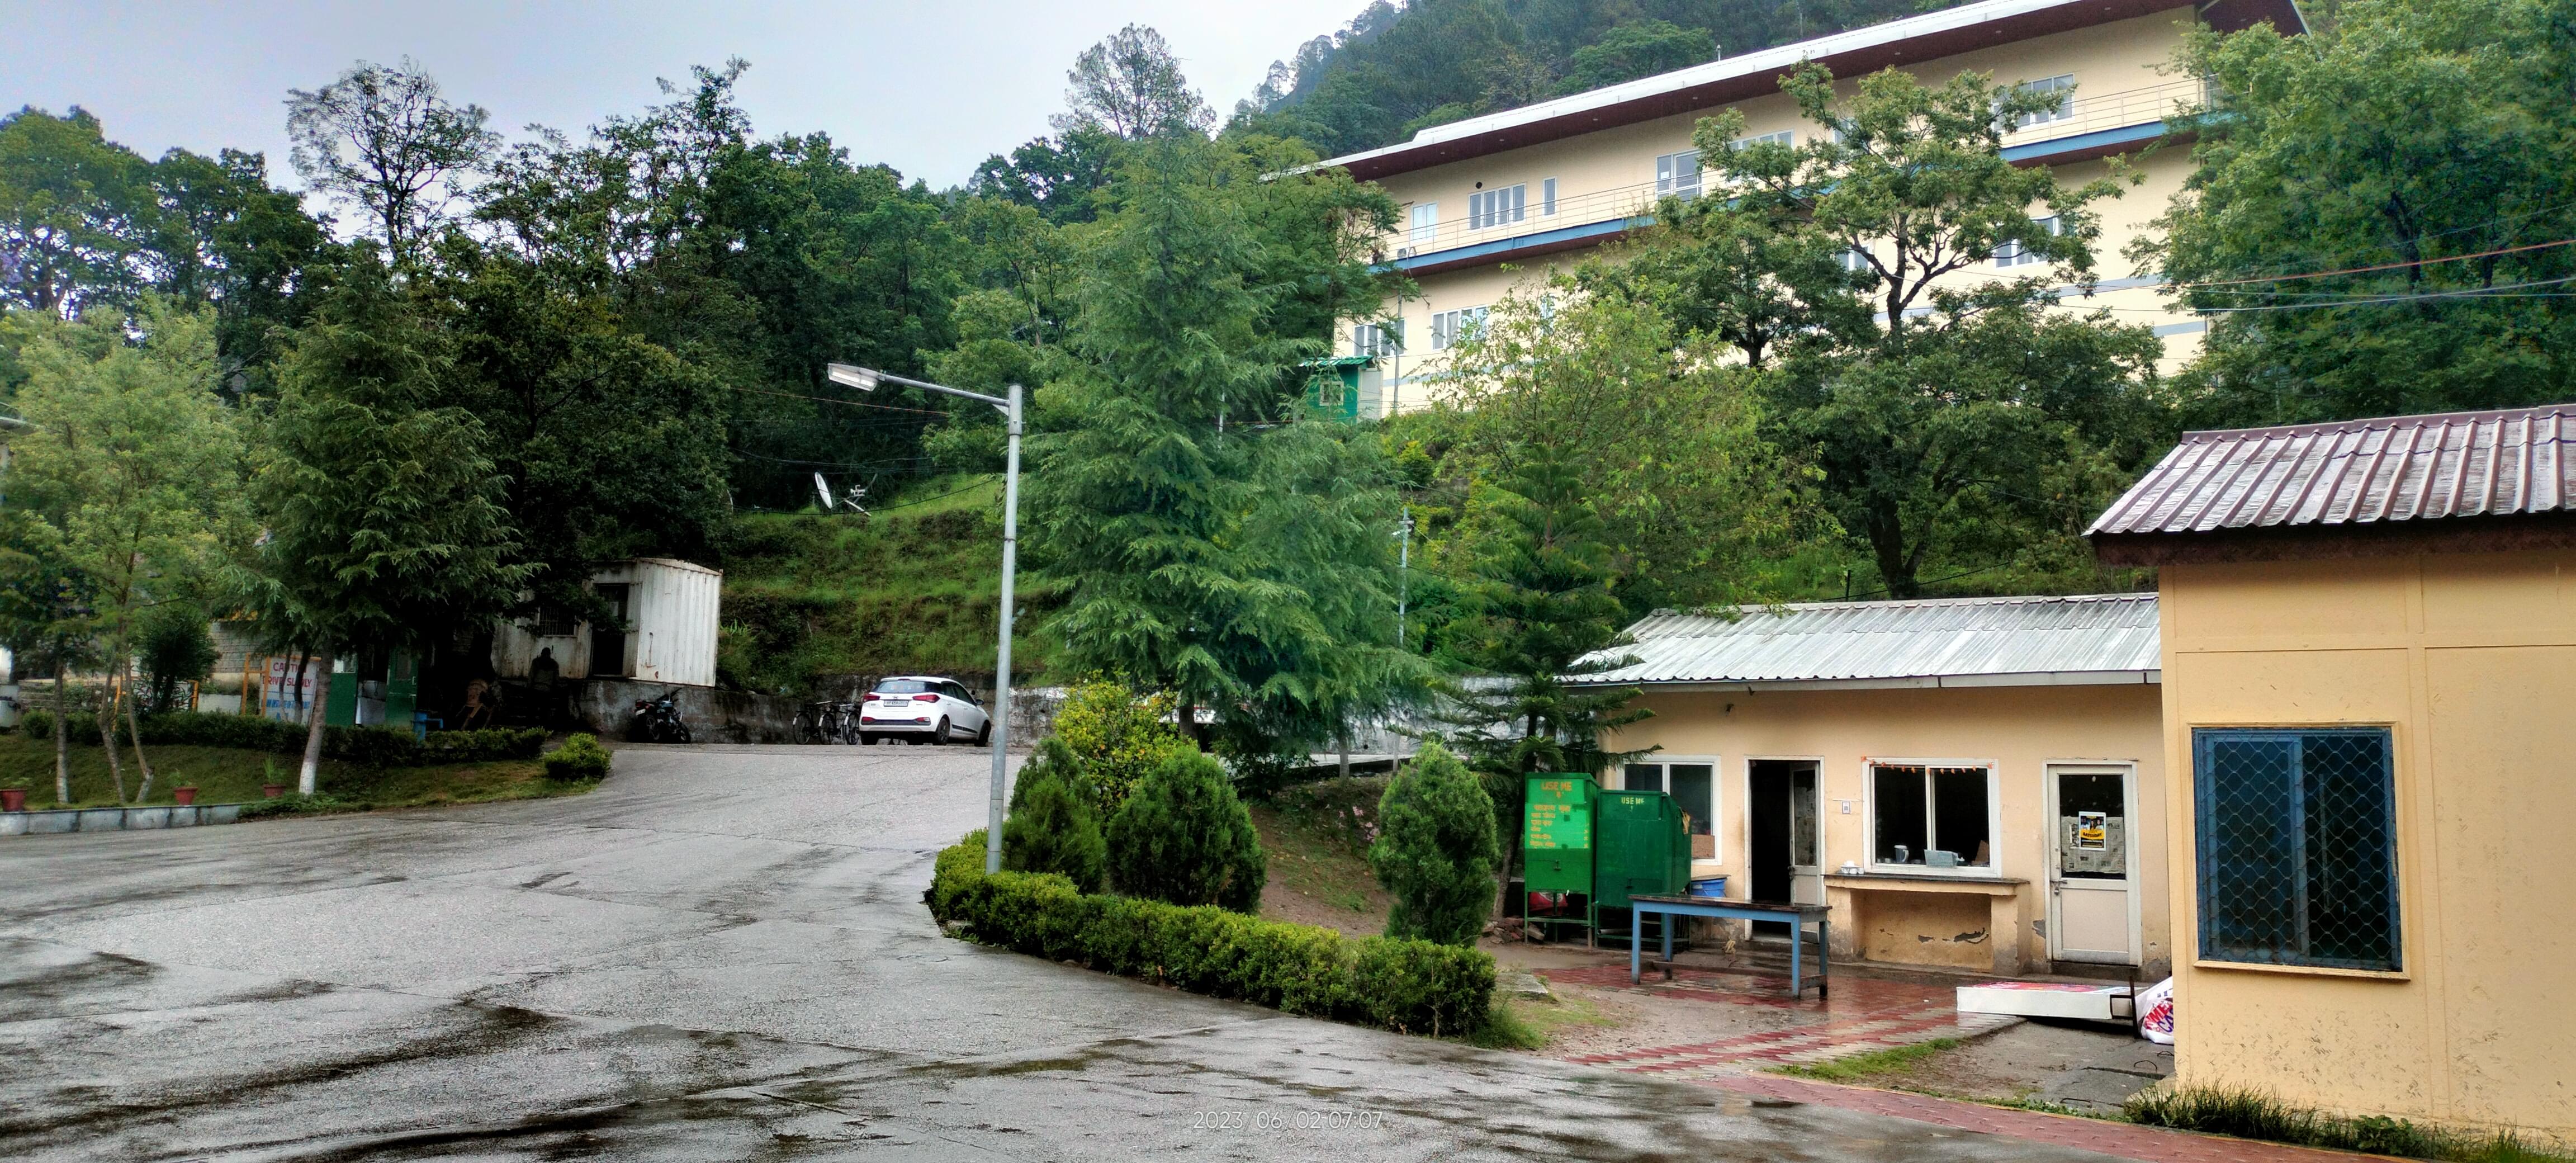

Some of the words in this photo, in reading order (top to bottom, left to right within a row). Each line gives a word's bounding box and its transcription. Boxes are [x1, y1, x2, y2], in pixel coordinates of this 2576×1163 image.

[273, 662, 307, 673] CATI
[287, 677, 312, 688] SLWLY
[1621, 796, 1635, 805] USE
